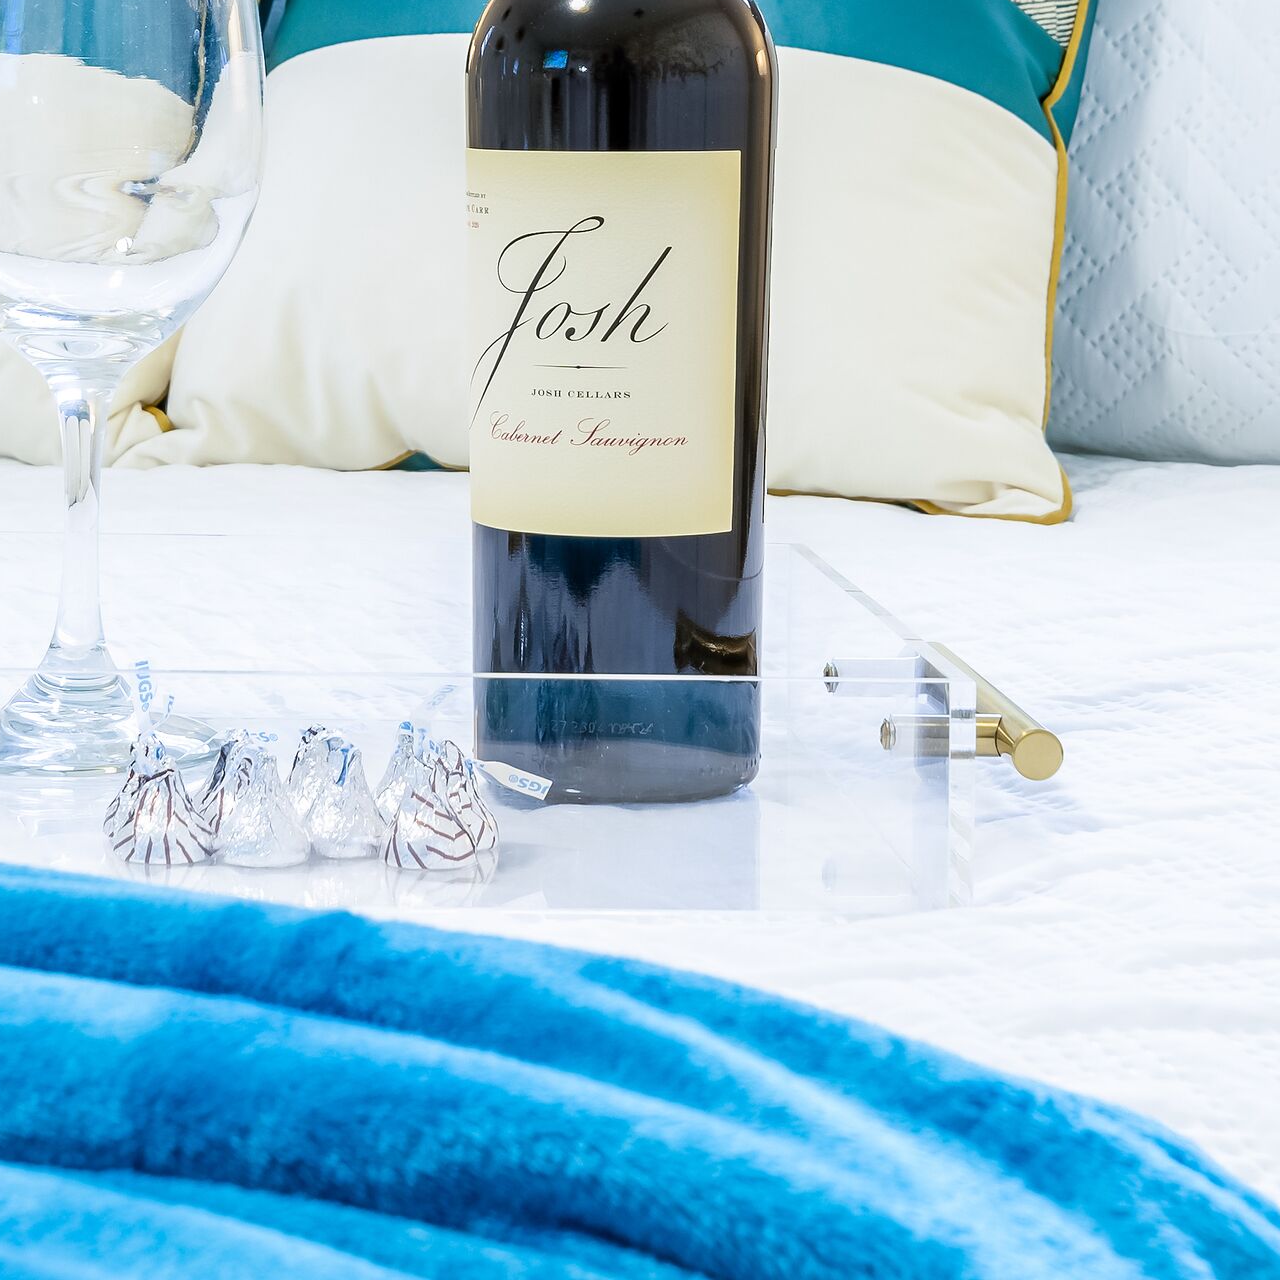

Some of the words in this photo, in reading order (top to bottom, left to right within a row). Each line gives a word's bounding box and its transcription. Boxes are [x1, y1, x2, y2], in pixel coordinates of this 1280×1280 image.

[469, 216, 672, 430] Josh
[531, 388, 562, 398] JOSH
[567, 390, 632, 399] CELLARS
[489, 410, 563, 446] Cabernet
[569, 417, 689, 457] Sauvignon
